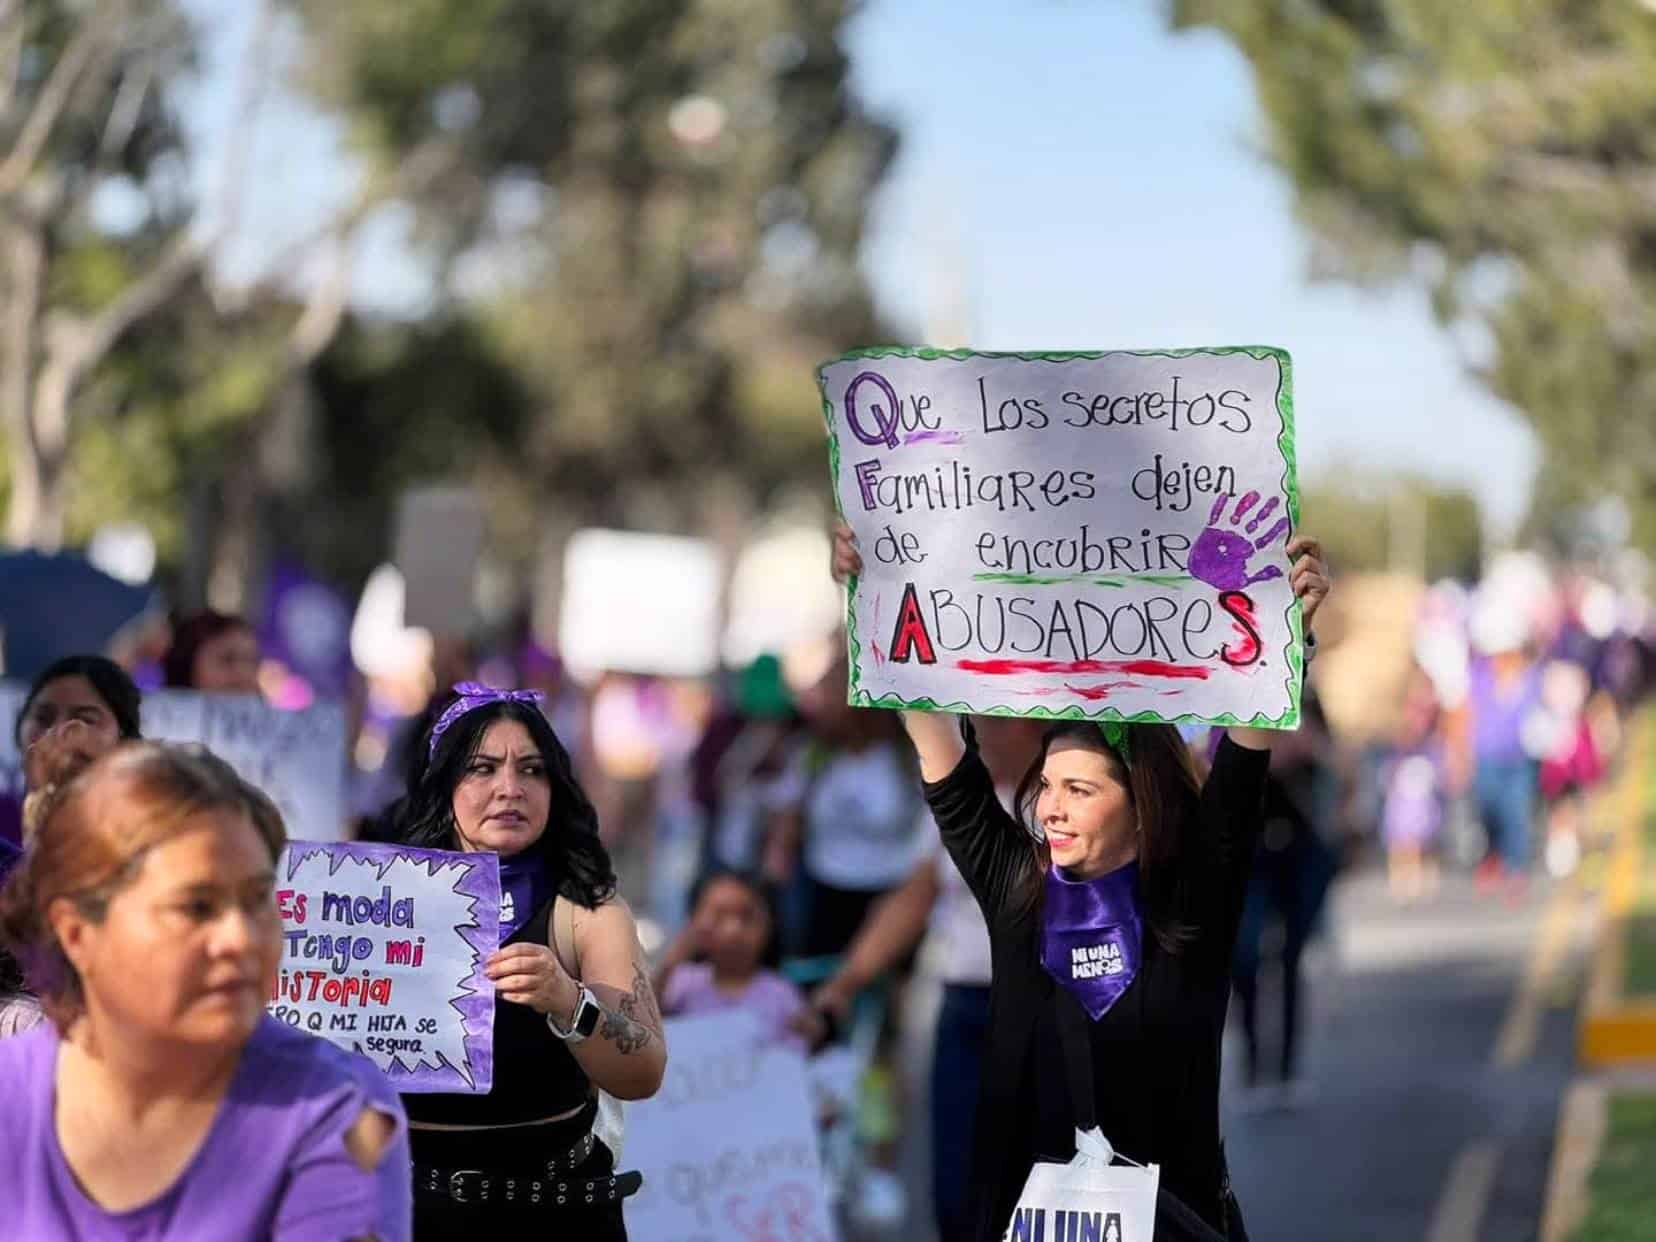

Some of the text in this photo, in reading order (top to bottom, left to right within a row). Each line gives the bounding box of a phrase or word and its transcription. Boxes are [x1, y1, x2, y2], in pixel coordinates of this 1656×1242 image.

[844, 371, 942, 450] Que
[1062, 376, 1252, 433] secretos
[1132, 454, 1237, 512] dejen
[874, 525, 928, 565] de
[322, 886, 414, 928] moda
[385, 936, 426, 967] mi
[307, 1011, 322, 1031] Q
[329, 1013, 358, 1031] MI
